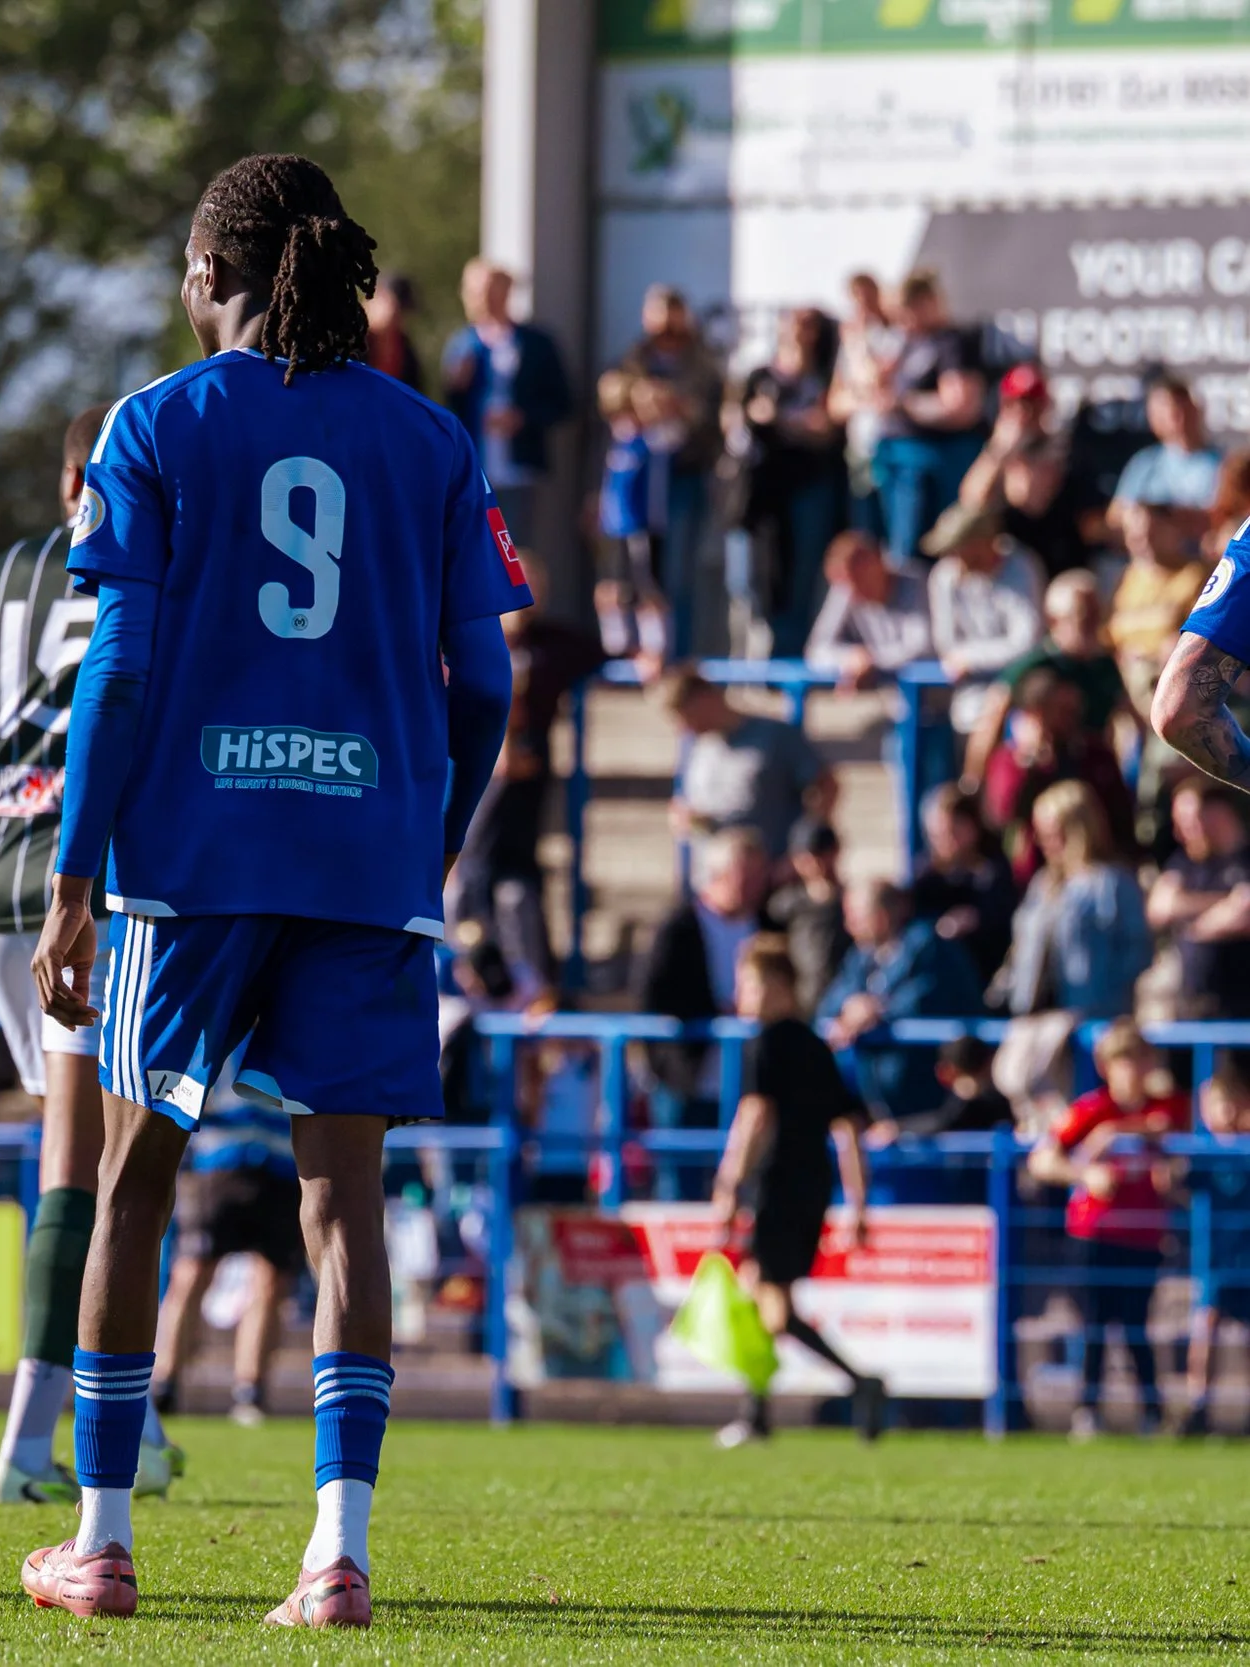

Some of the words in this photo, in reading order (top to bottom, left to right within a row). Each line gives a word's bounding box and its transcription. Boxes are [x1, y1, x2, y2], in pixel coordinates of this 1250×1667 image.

[258, 456, 346, 640] 9
[218, 730, 362, 777] HiSPEC
[215, 778, 233, 789] LIFE
[235, 778, 268, 789] SAFETY
[315, 783, 362, 798] SOLUTIONS
